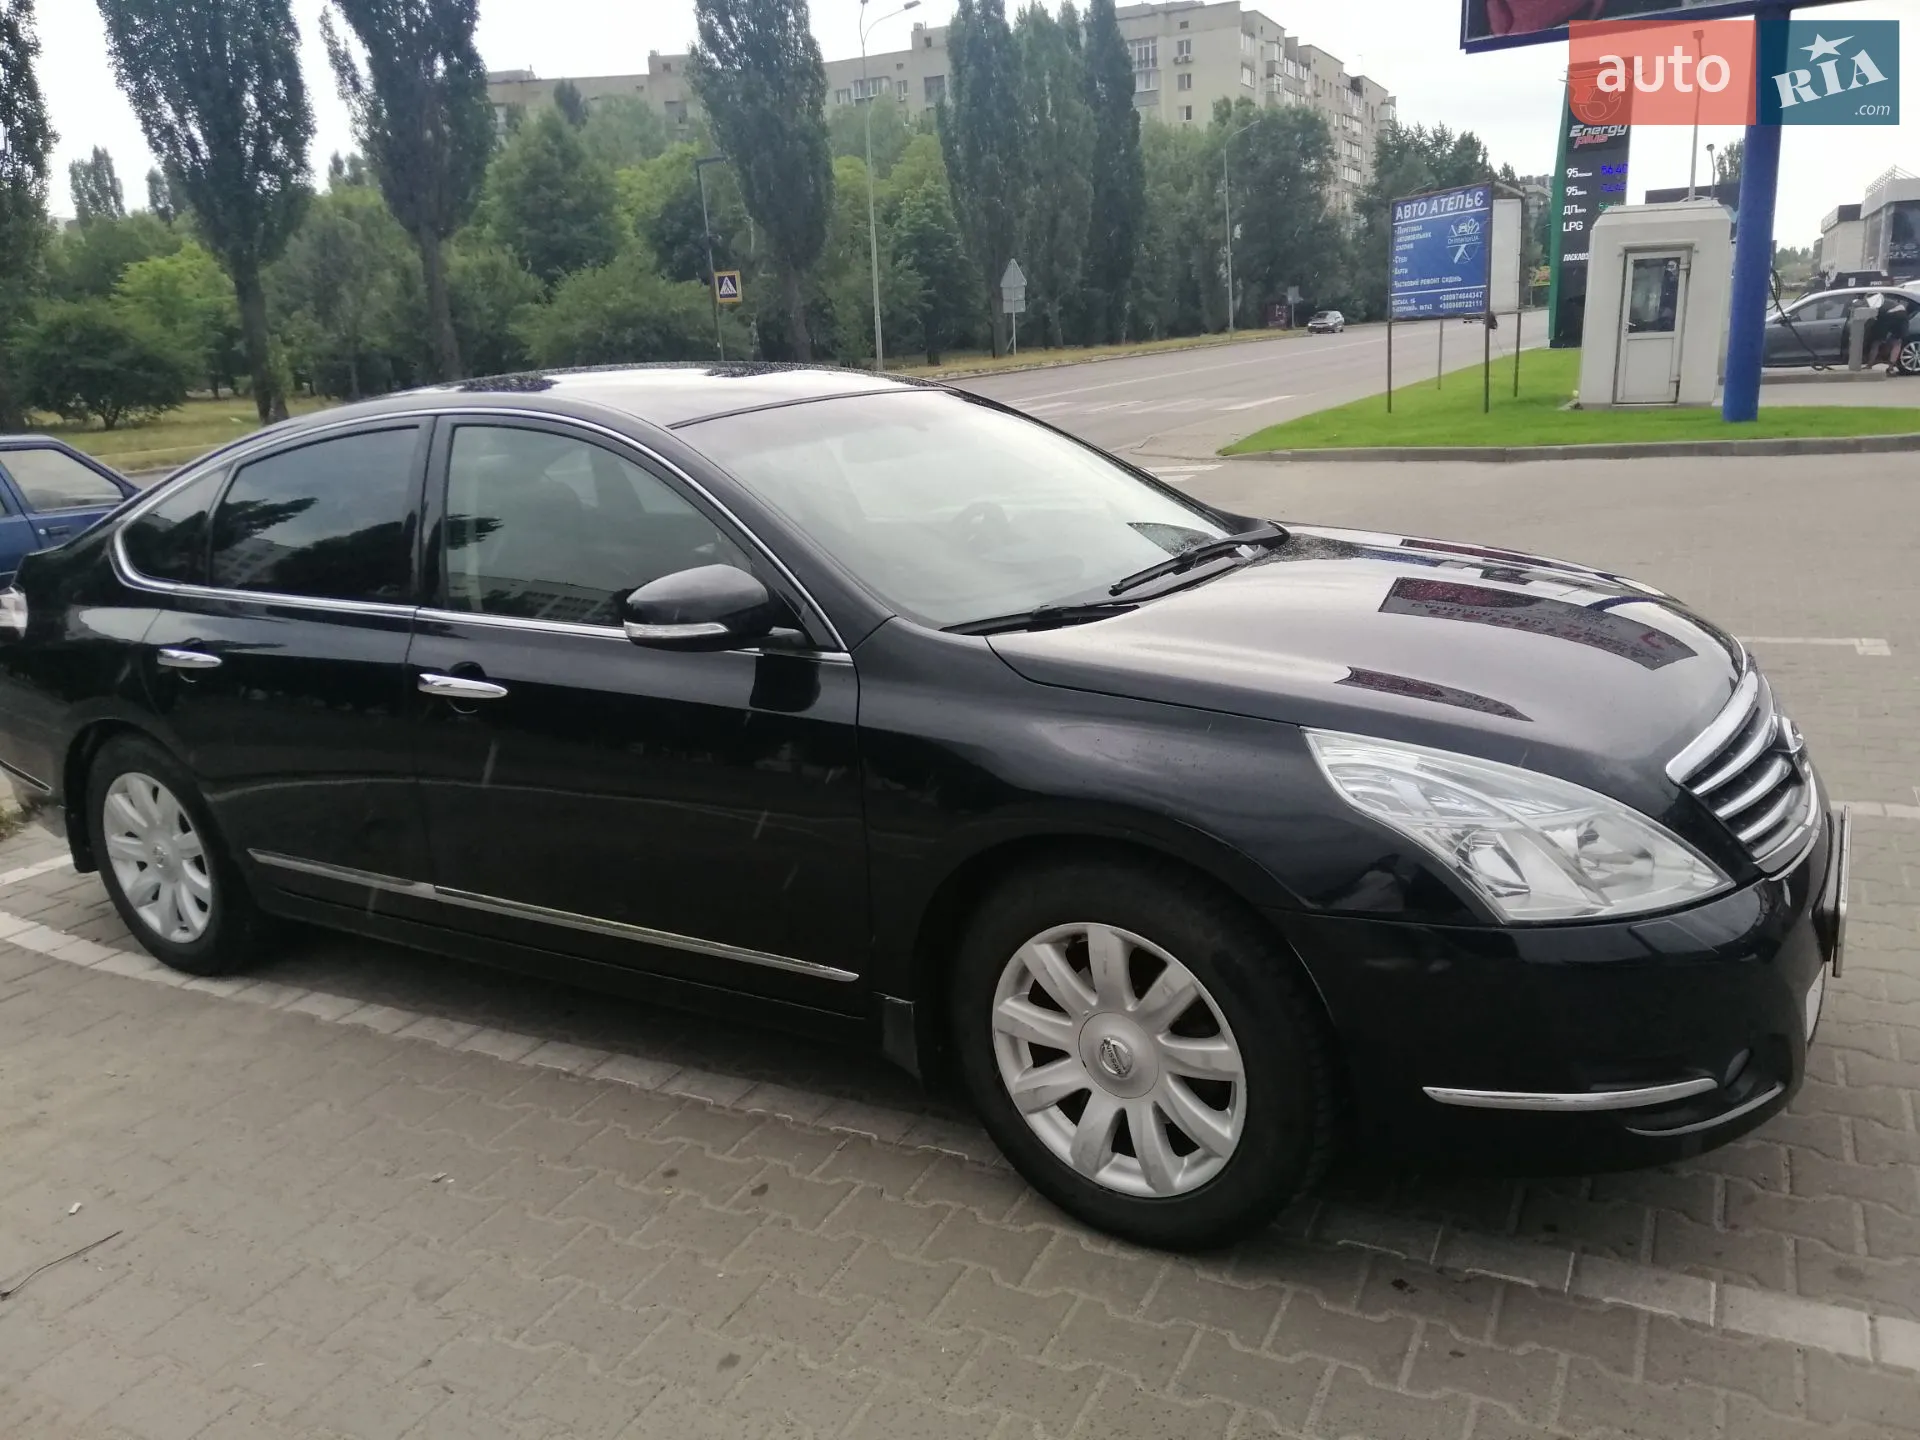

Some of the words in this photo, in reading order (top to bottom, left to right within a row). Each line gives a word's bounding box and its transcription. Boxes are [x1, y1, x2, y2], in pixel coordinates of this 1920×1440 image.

[1569, 124, 1628, 137] Energy
[1566, 167, 1579, 179] 95
[1395, 201, 1427, 220] АВТО
[1430, 191, 1484, 214] АТЕЛЬЄ
[1562, 221, 1583, 232] LPG
